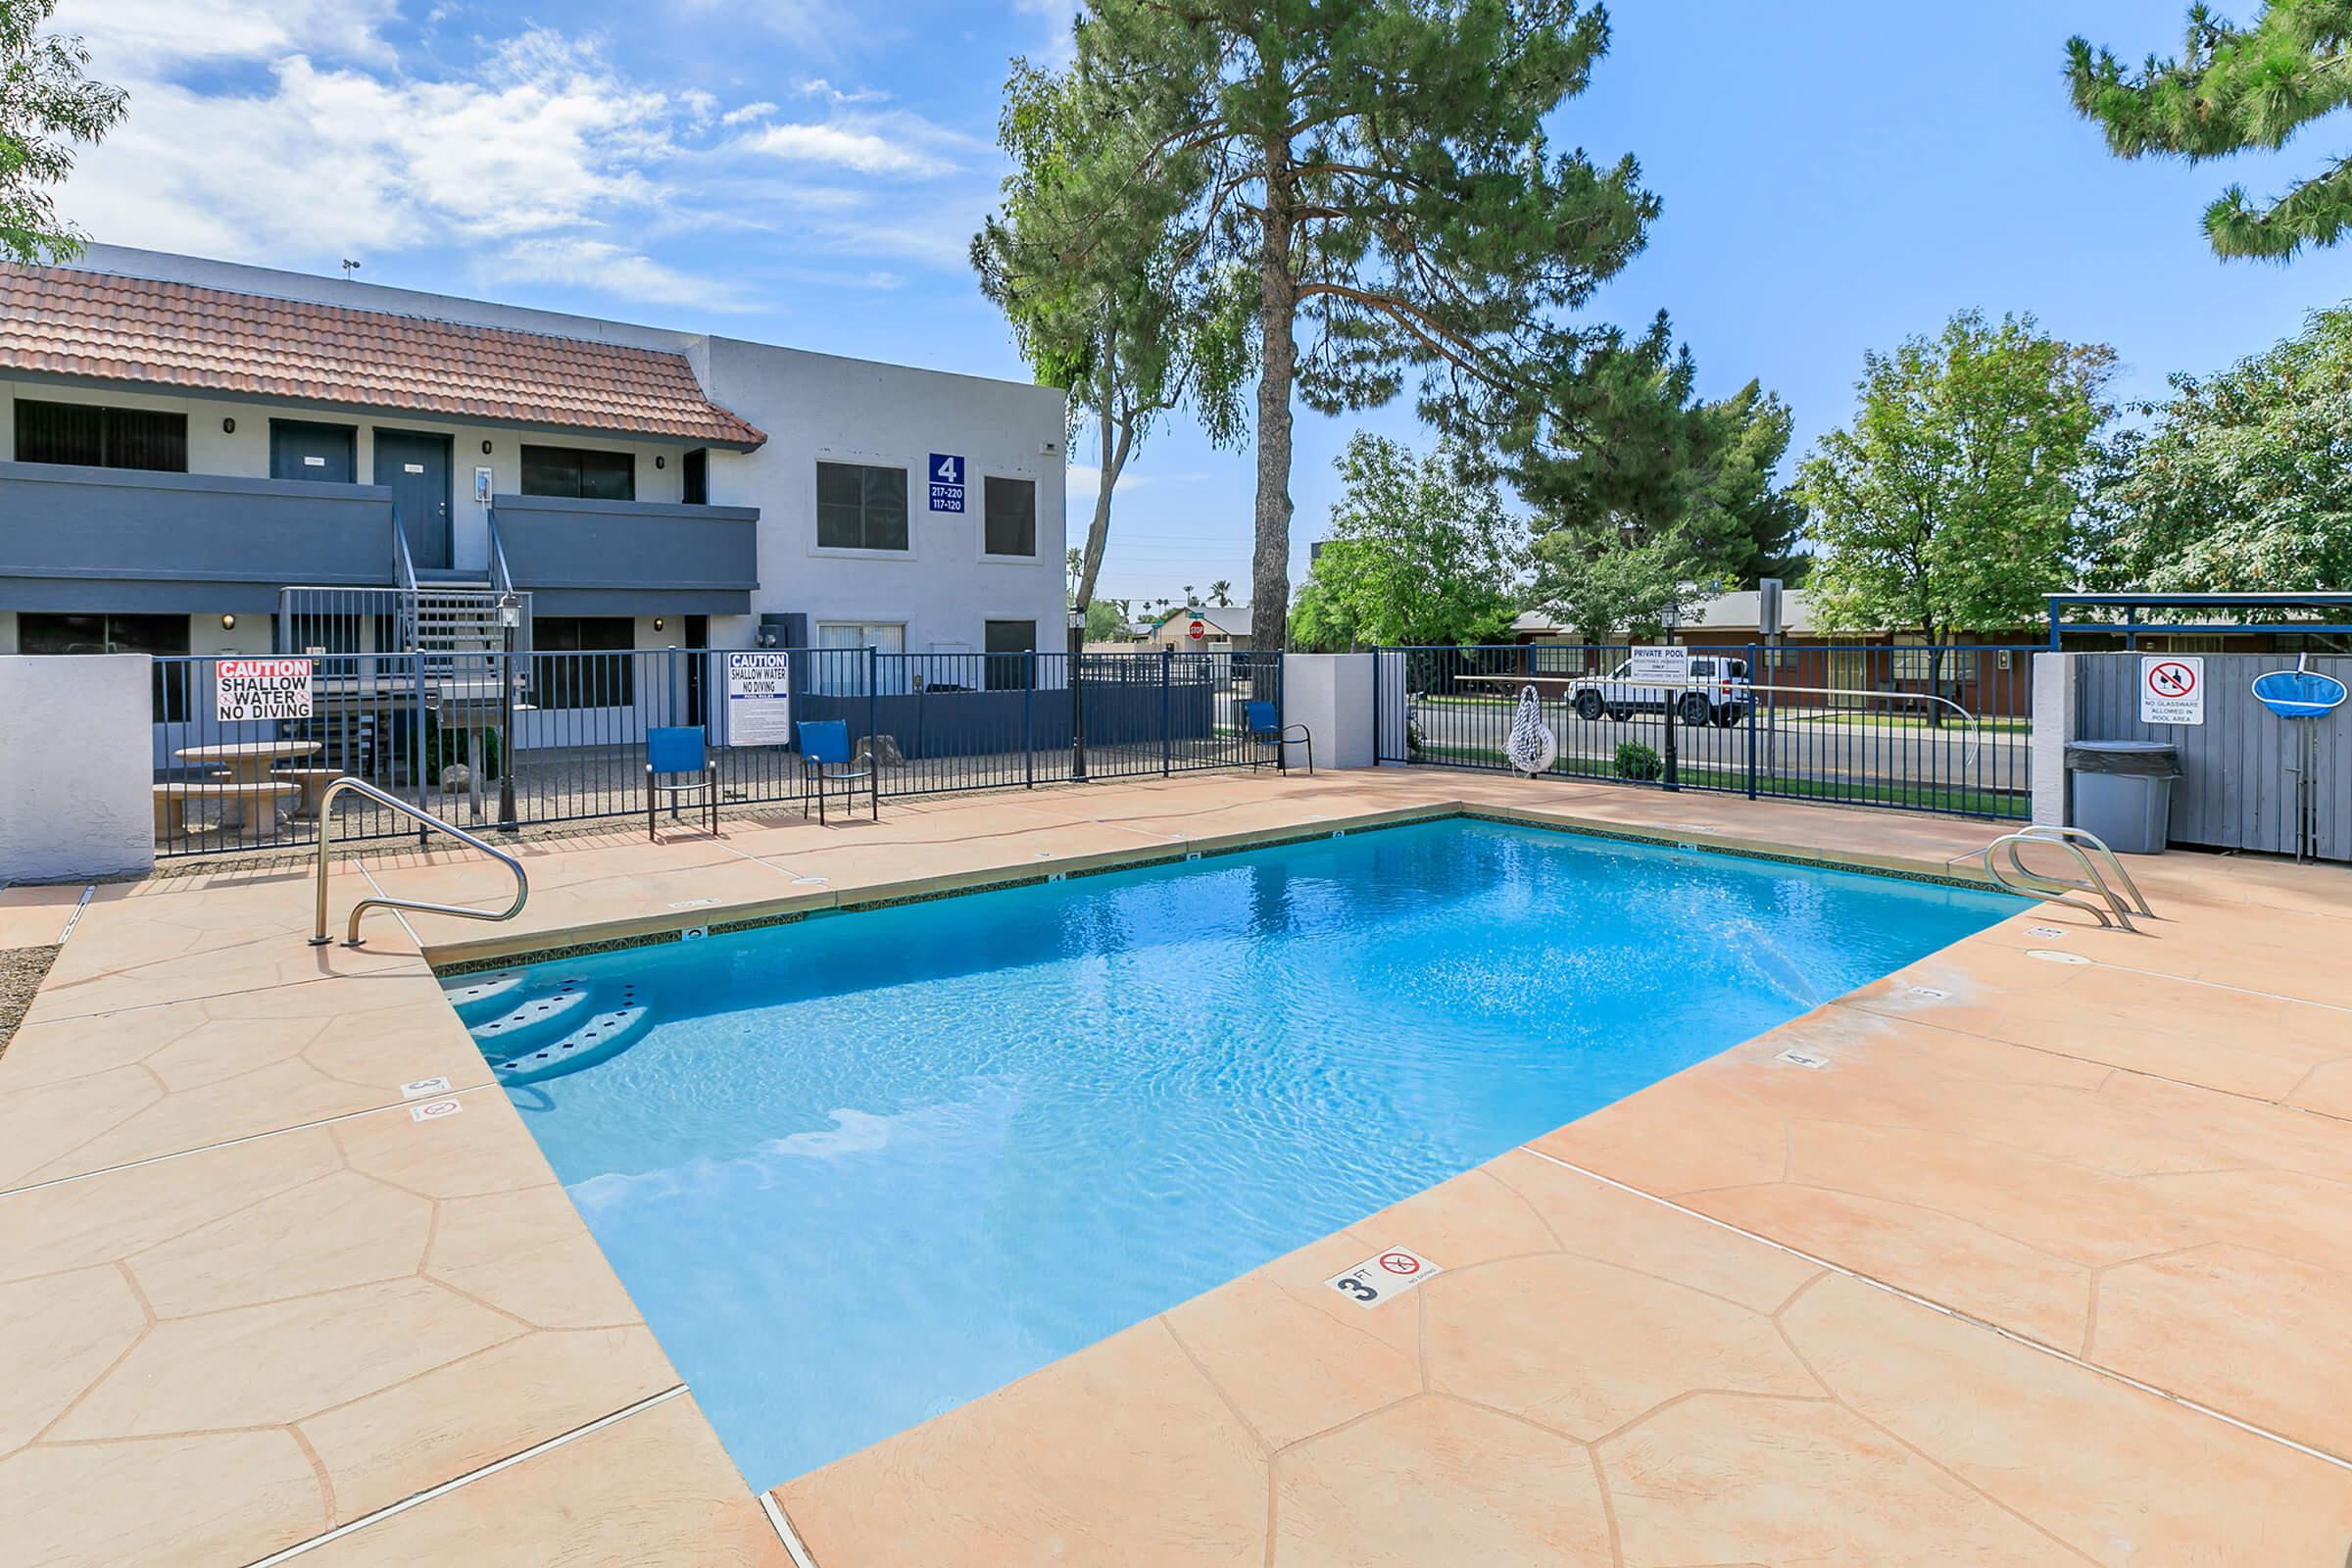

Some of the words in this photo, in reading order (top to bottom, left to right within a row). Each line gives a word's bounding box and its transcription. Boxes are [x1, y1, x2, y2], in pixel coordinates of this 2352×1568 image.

[938, 457, 956, 482] 4
[932, 487, 962, 499] 217-220
[933, 499, 961, 511] 117-120
[732, 655, 785, 667] CAUTION
[220, 661, 308, 677] CAUTION
[731, 668, 762, 680] SHALLOW
[764, 668, 786, 680] WATER
[221, 677, 307, 692] SHALLOW
[743, 682, 752, 692] NO
[754, 681, 775, 692] DIVING
[234, 691, 295, 705] WATER
[220, 706, 244, 719] NO
[253, 704, 310, 718] DIVING
[1353, 1268, 1373, 1282] FT
[1338, 1278, 1378, 1301] 3
